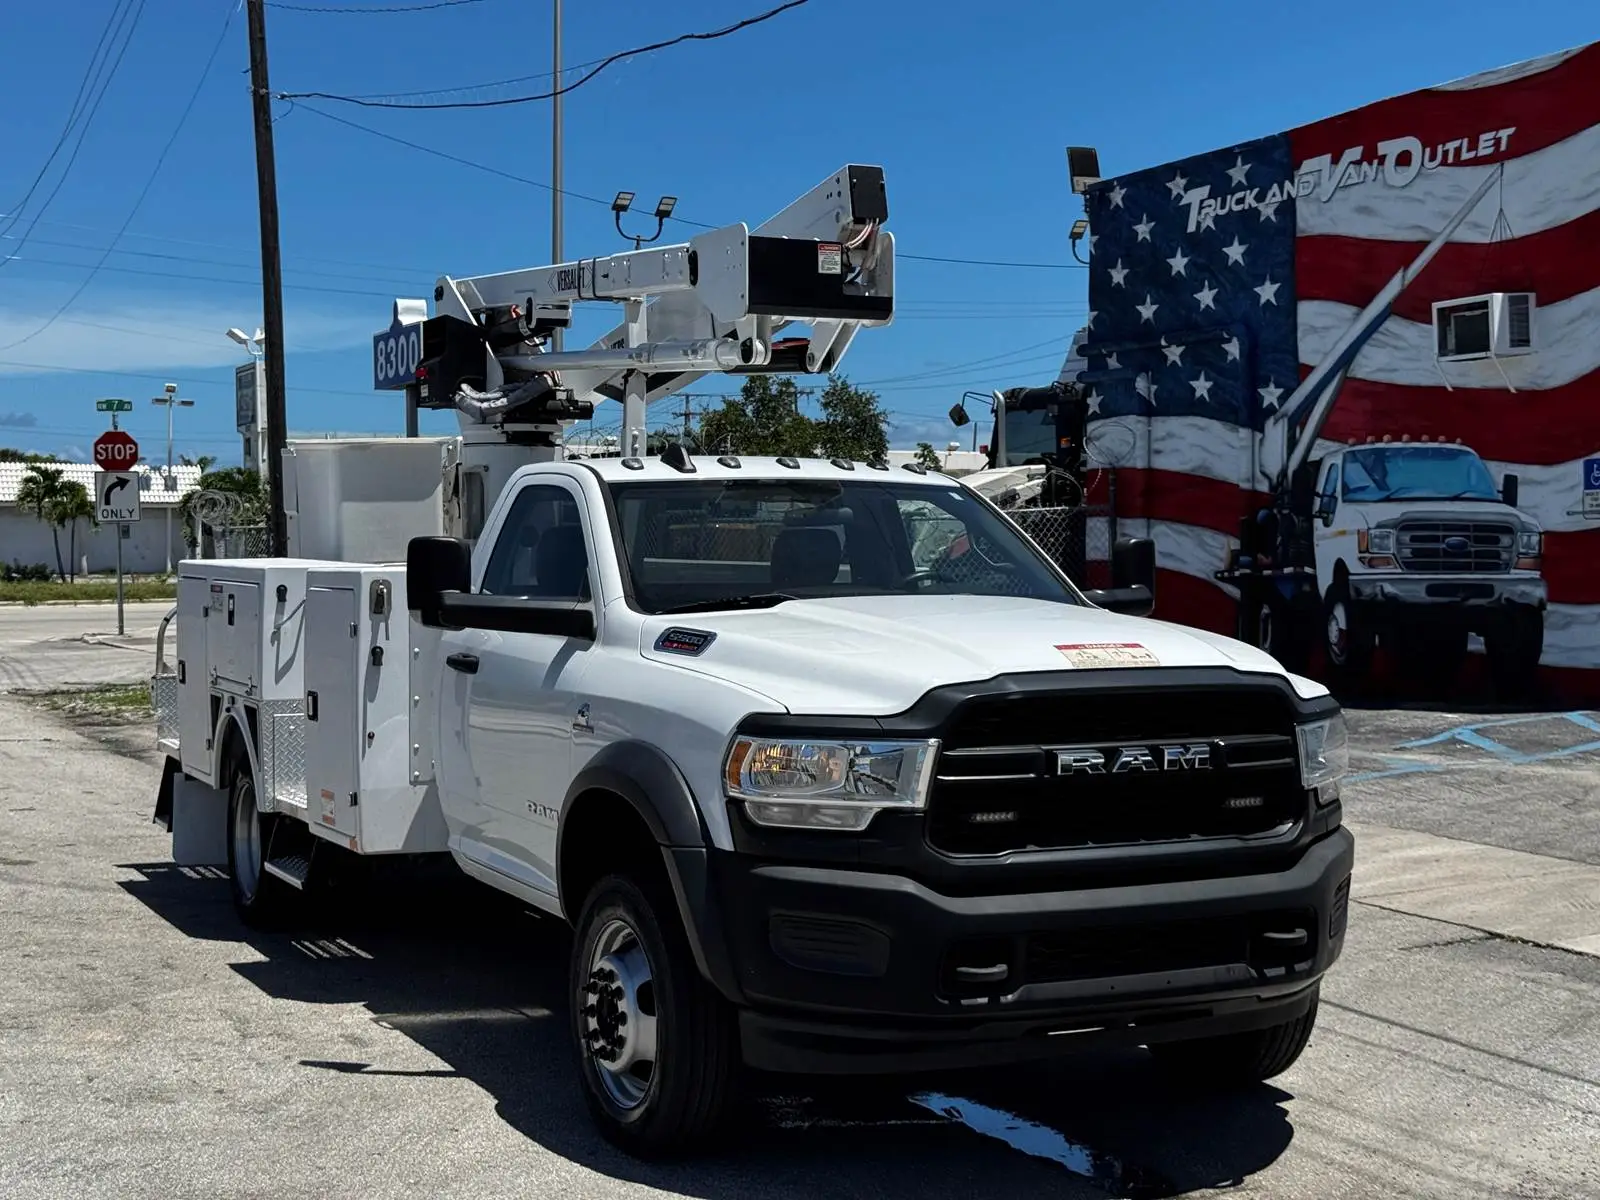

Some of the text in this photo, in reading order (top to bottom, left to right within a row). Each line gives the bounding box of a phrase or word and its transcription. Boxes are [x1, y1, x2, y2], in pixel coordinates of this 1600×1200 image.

[1180, 136, 1516, 233] TRUCK AND VAN OUTLET
[377, 331, 418, 381] 8300
[112, 400, 118, 411] 7
[96, 444, 136, 460] STOP
[101, 508, 135, 519] ONLY
[1053, 744, 1213, 776] RAM
[526, 799, 560, 821] RAM
